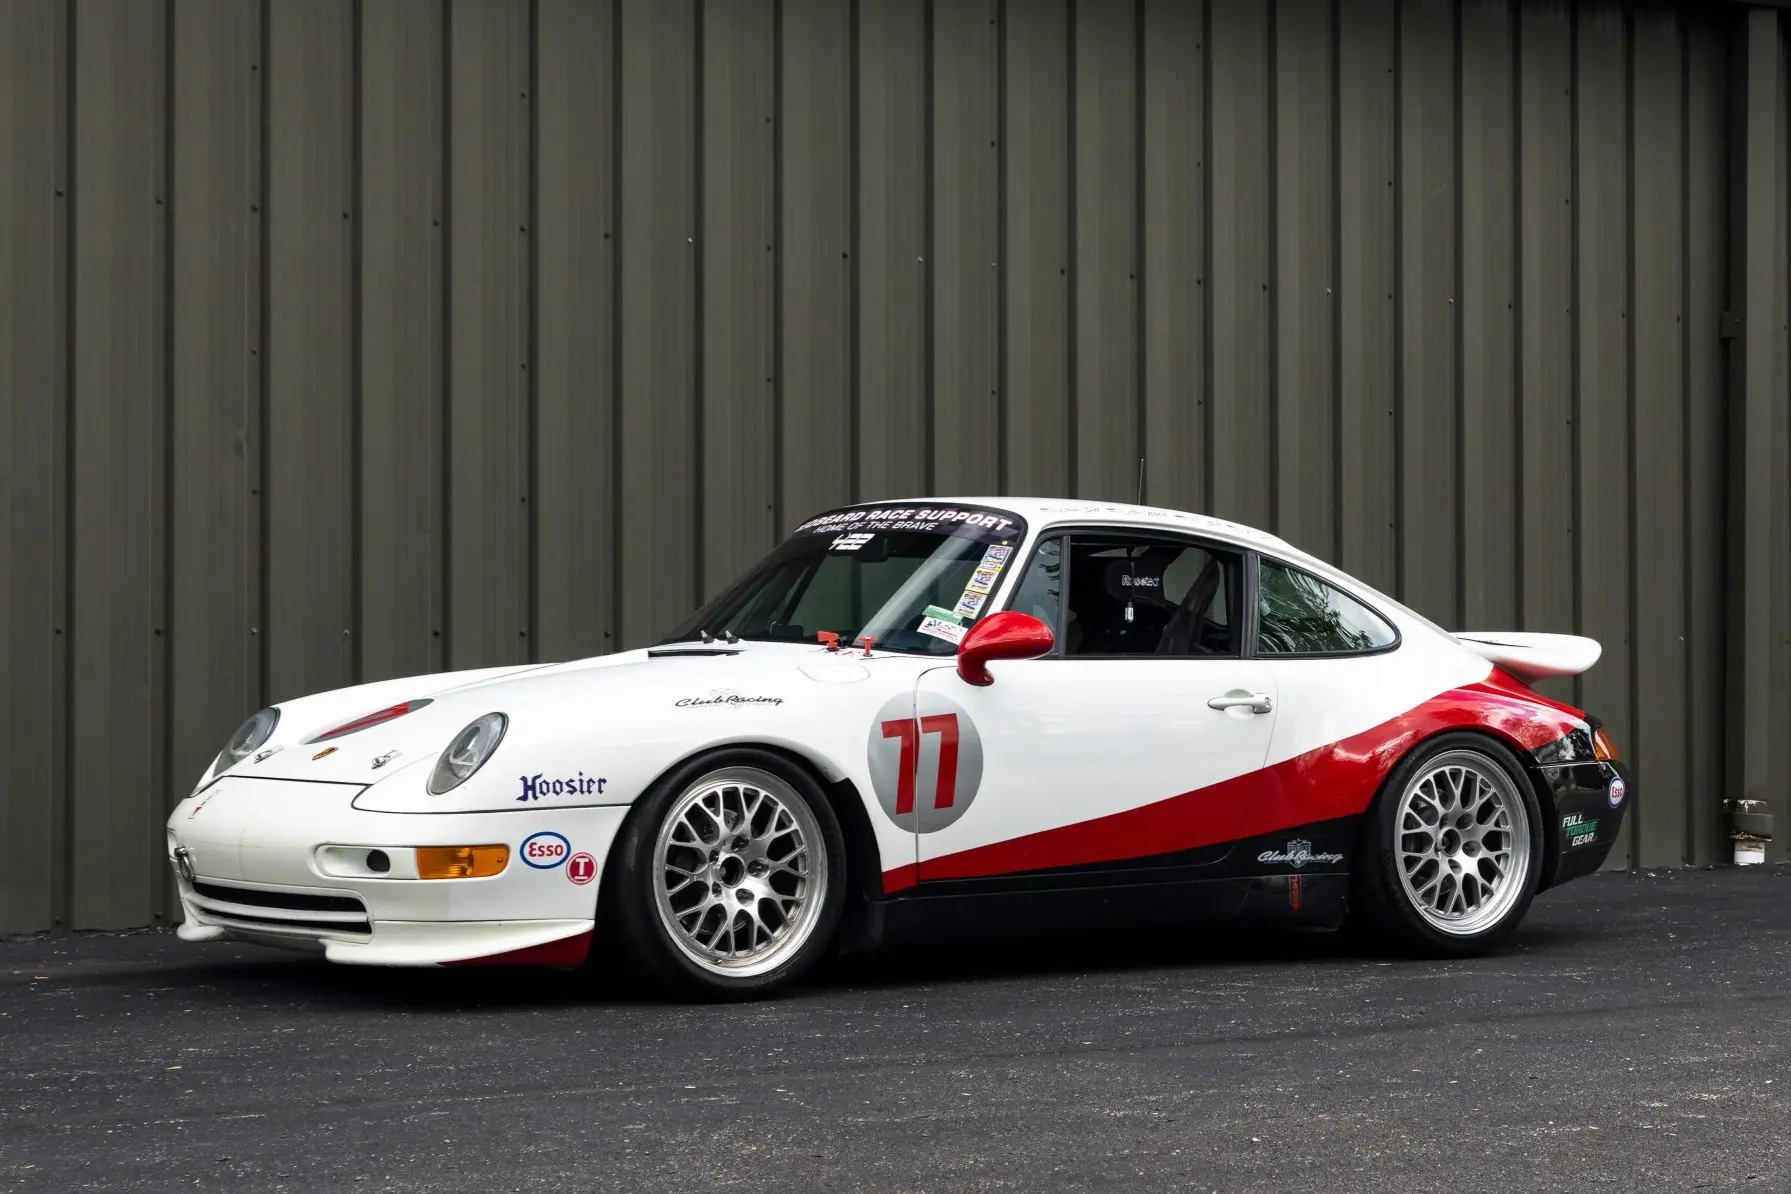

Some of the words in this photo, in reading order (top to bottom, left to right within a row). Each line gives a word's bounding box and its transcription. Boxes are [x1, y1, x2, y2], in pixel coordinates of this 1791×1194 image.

[812, 523, 849, 534] HOME
[847, 521, 867, 531] OF
[866, 521, 893, 529] THE
[891, 521, 939, 531] BRAVE
[865, 509, 916, 520] RACE
[914, 509, 1013, 531] SUPPORT
[881, 712, 960, 815] 77
[516, 770, 607, 801] Hoosier
[1562, 813, 1584, 828] FULL
[1571, 832, 1595, 847] GEAR
